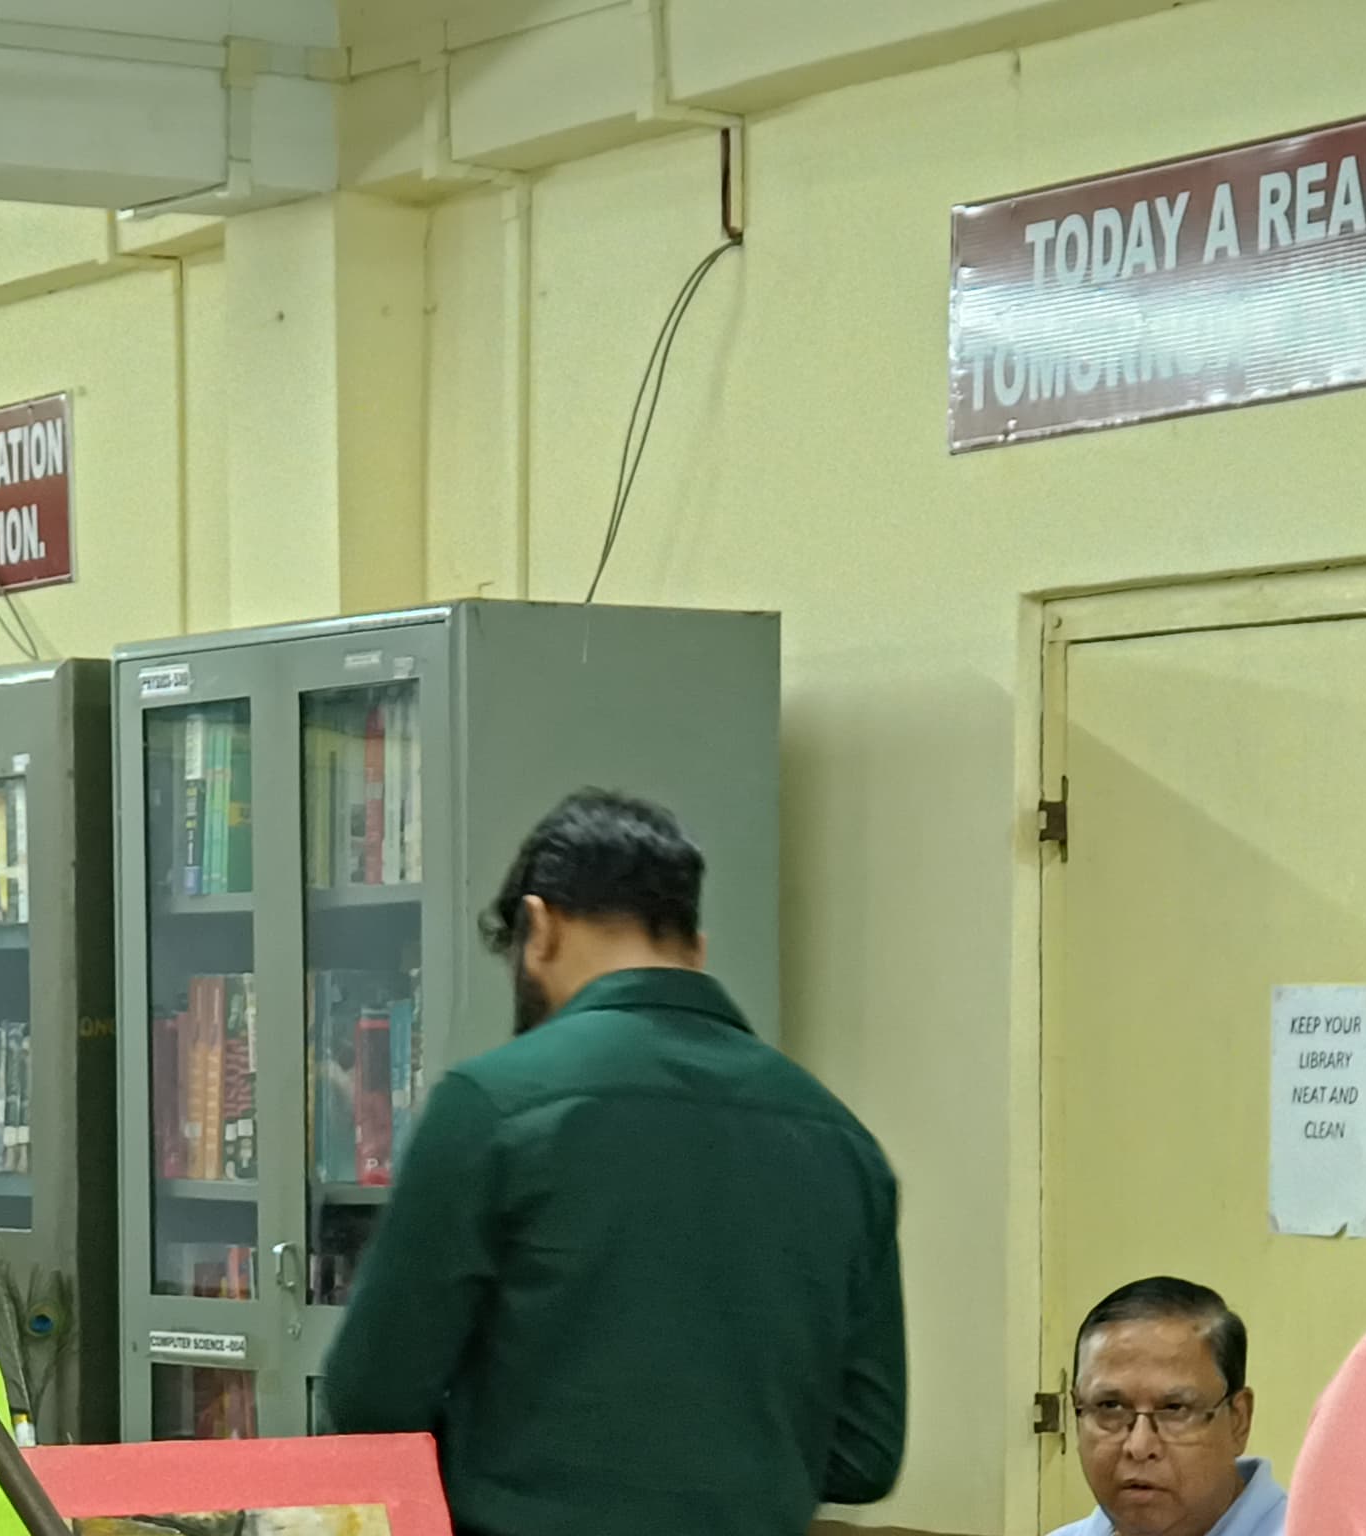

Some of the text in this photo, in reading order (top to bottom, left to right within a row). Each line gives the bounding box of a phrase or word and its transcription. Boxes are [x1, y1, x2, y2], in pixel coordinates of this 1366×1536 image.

[1025, 191, 1191, 289] TODAY
[1202, 183, 1241, 265] A
[1290, 1015, 1362, 1034] KEEP YOUR
[1299, 1051, 1353, 1070] LIBRARY
[1292, 1086, 1359, 1105] NEAT AND
[1304, 1120, 1346, 1139] CLEAN
